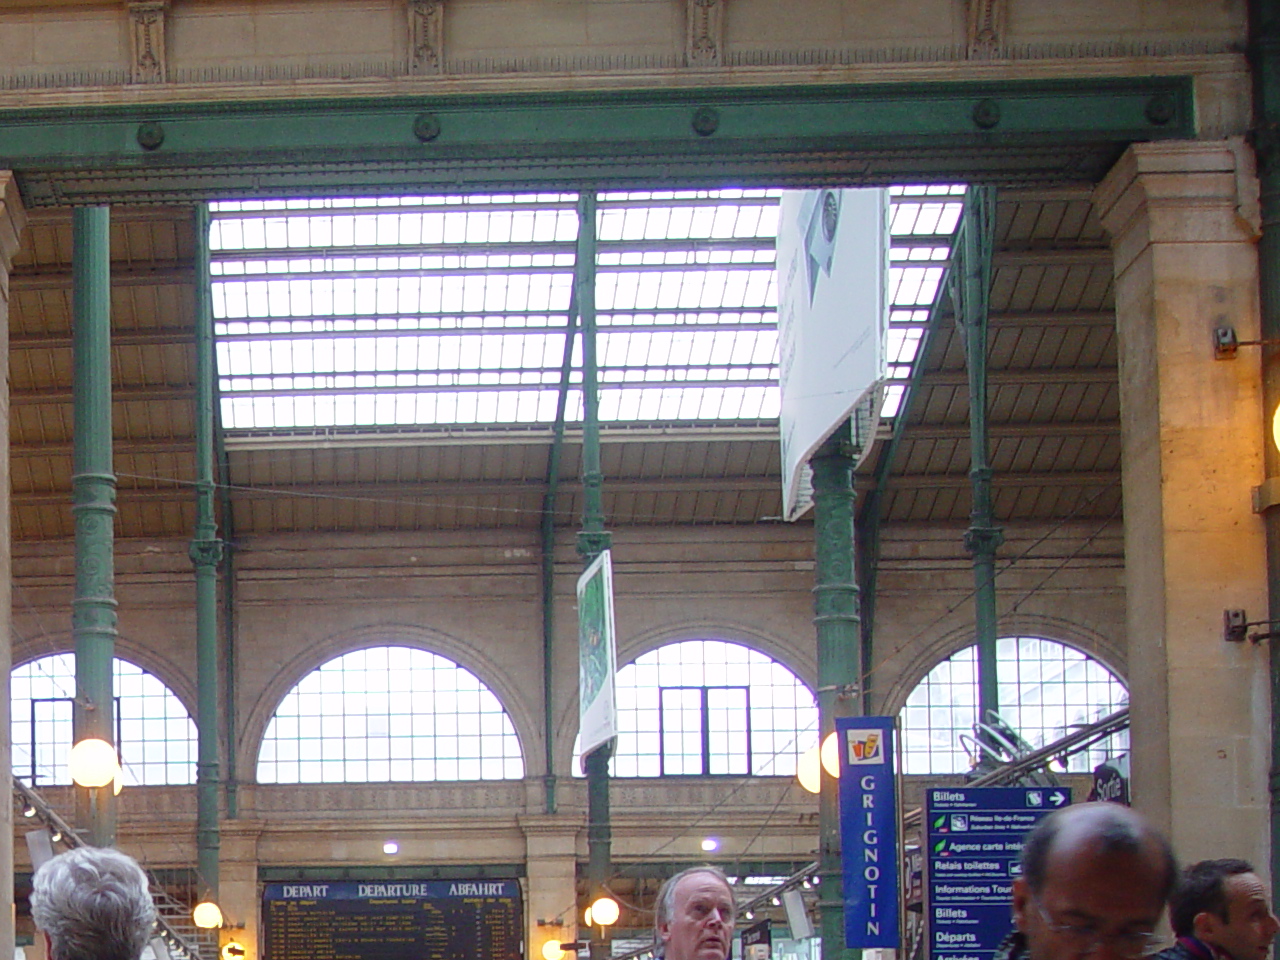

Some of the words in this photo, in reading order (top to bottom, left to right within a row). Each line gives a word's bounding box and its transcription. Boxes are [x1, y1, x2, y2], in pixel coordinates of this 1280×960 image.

[1097, 772, 1121, 802] Sortie
[933, 791, 965, 802] Billets
[860, 774, 881, 938] GRIGNOTIN
[935, 861, 962, 870] Relais
[964, 861, 1000, 870] toilettes
[283, 884, 329, 899] DEPART
[358, 884, 428, 899] DEPARTURE
[449, 882, 505, 897] ABFAHRT
[935, 884, 991, 895] Informations
[935, 908, 967, 918] Billets
[935, 931, 976, 943] Départs
